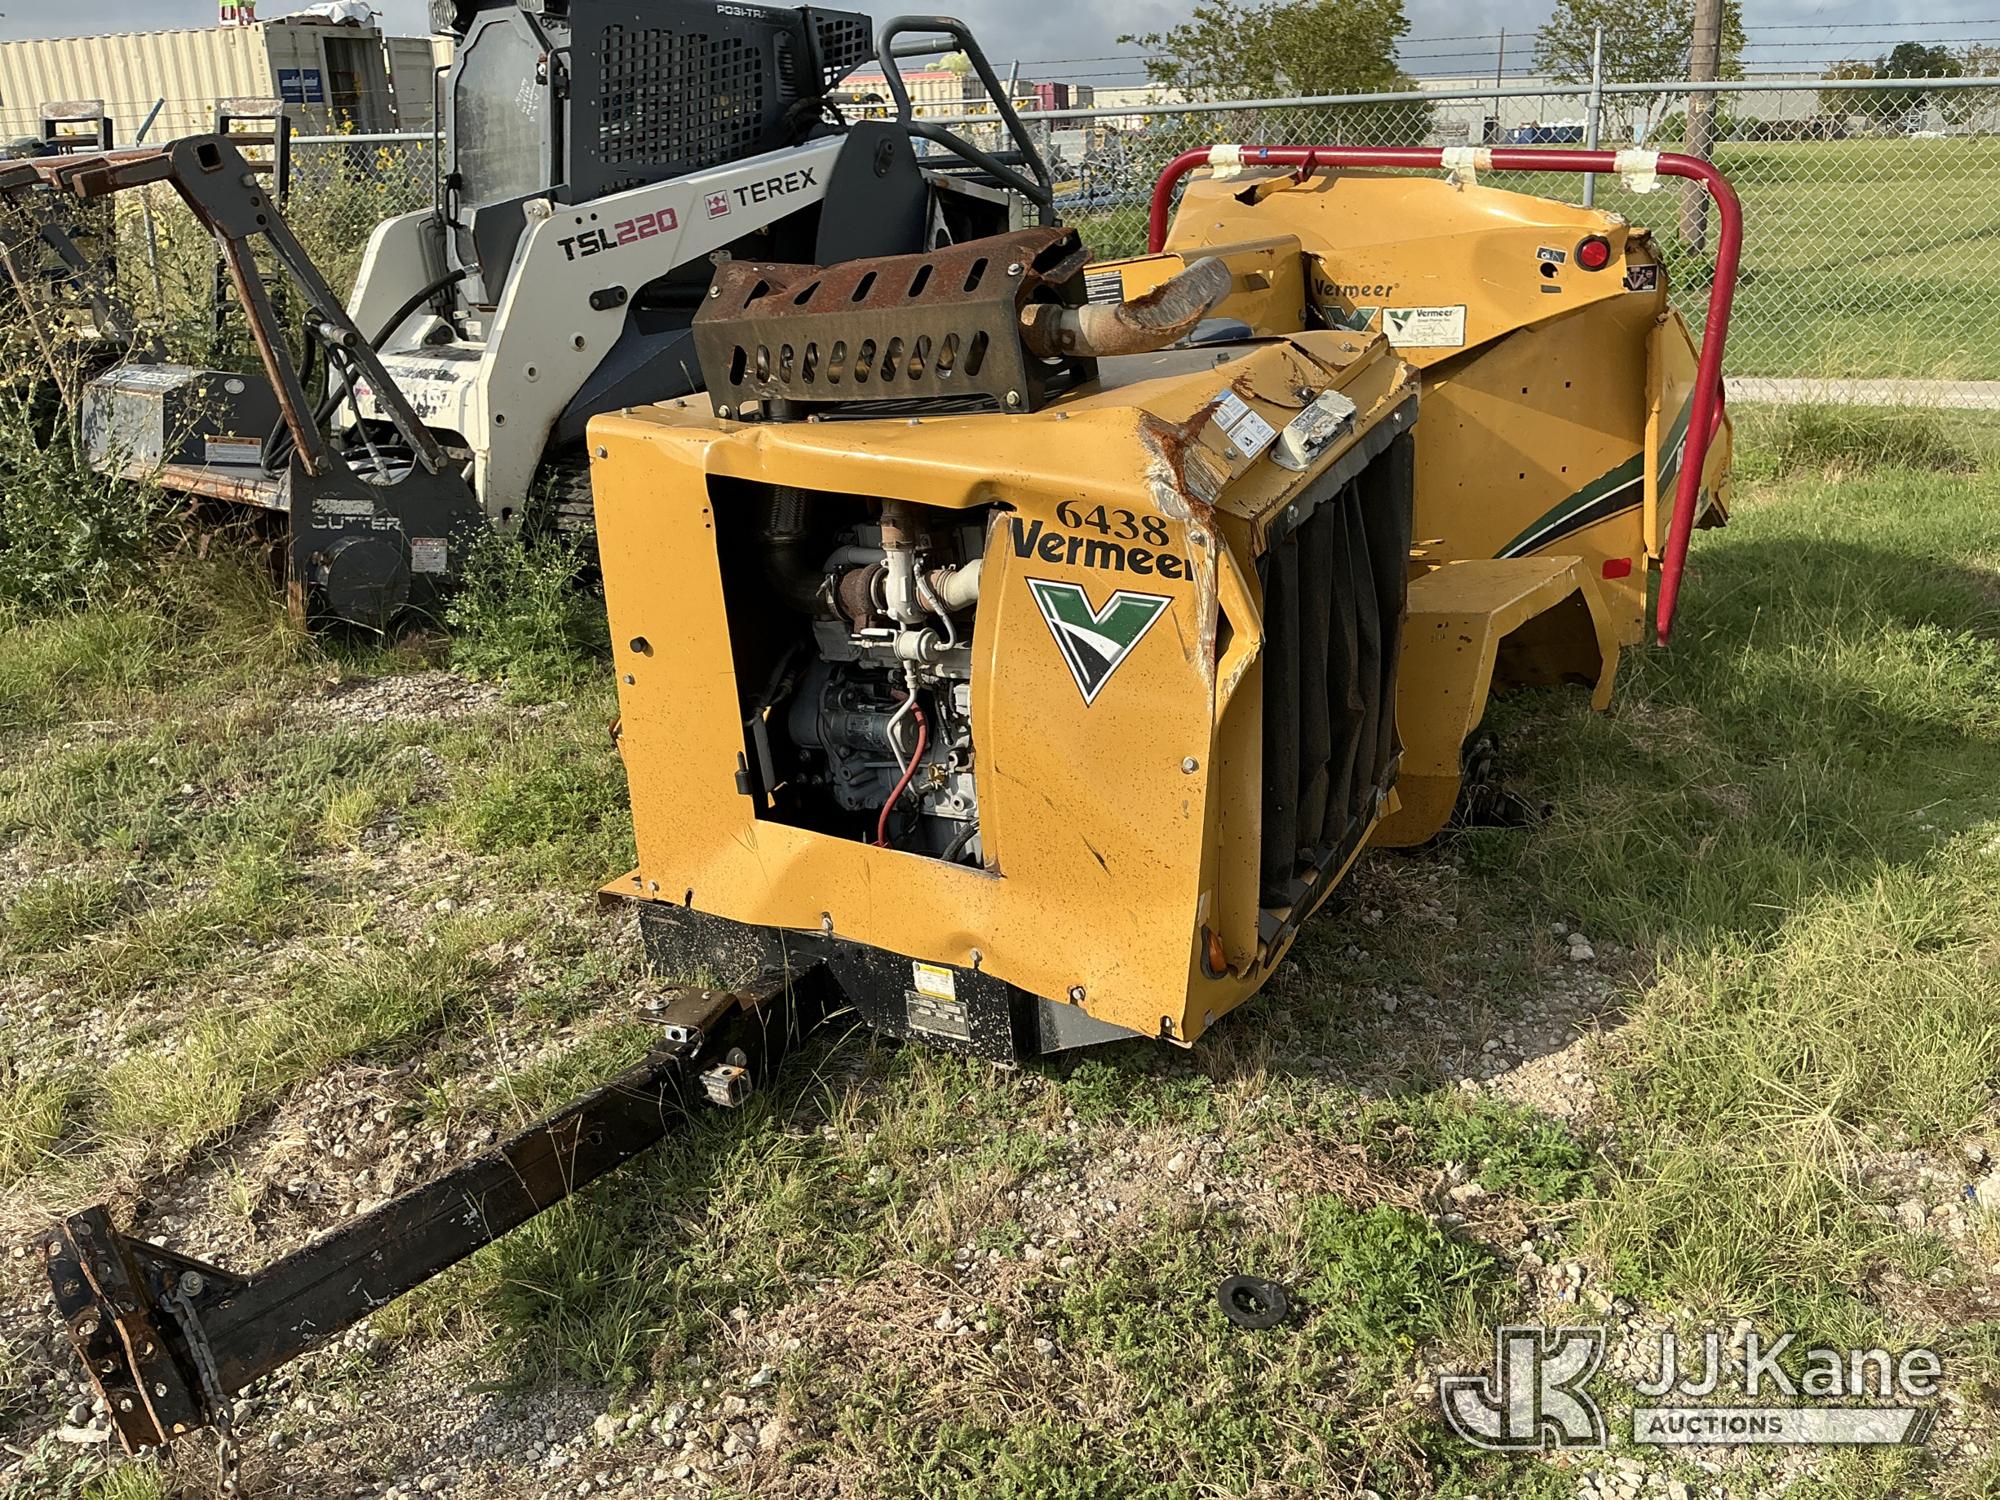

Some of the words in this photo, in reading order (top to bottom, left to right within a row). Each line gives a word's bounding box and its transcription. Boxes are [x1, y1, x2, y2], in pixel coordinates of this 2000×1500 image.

[733, 167, 818, 206] TEREX
[557, 207, 679, 261] TSL220
[1416, 309, 1453, 317] Vermeer
[1056, 500, 1170, 547] 6438
